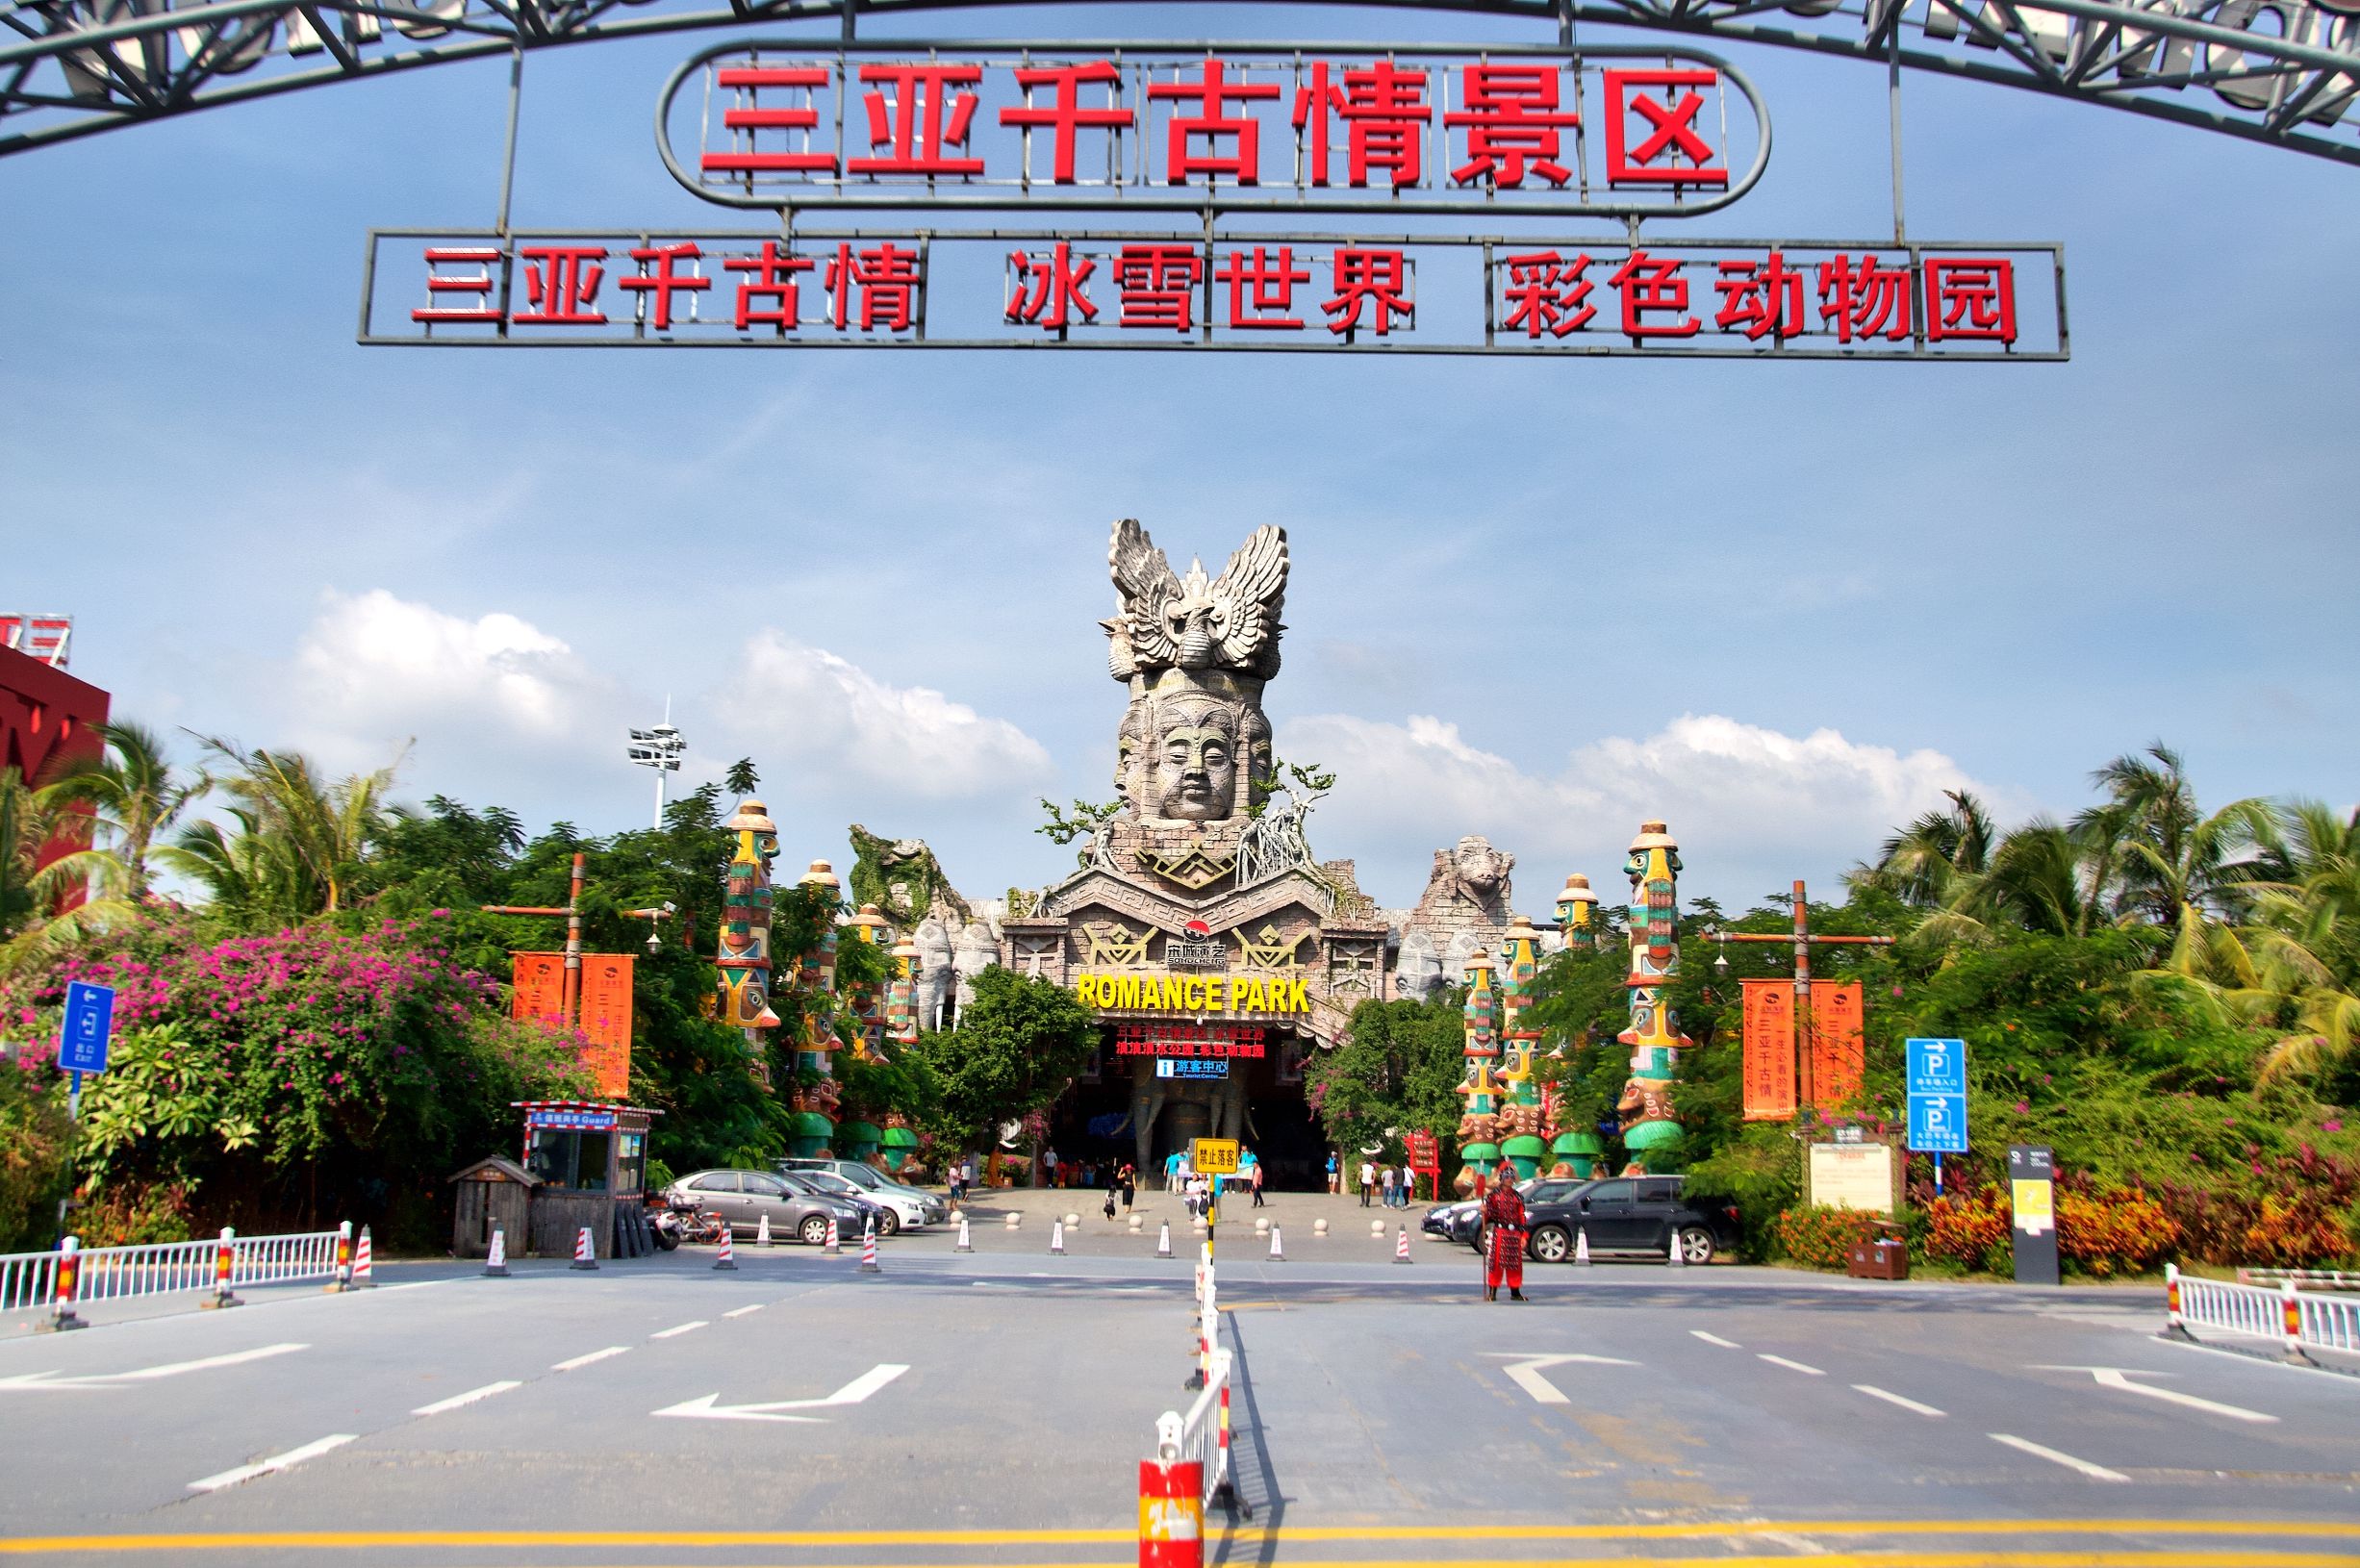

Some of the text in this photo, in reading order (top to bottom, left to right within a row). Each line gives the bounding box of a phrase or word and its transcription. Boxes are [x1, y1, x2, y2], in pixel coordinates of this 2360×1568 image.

[700, 58, 1729, 187] 三亚千古情景区
[411, 241, 2017, 343] 三亚千古情 冰雪世界 彩色动物园
[1167, 944, 1226, 957] 宋城演艺
[1078, 974, 1309, 1013] ROMANCE PARK
[1200, 1043, 1265, 1058] 彩色动物园
[1758, 1019, 1772, 1098] 三亚千古情
[1175, 1059, 1228, 1074] 游客中心
[1928, 1054, 1944, 1075] P
[581, 1115, 610, 1125] Guard
[1199, 1148, 1234, 1167] 禁止落客
